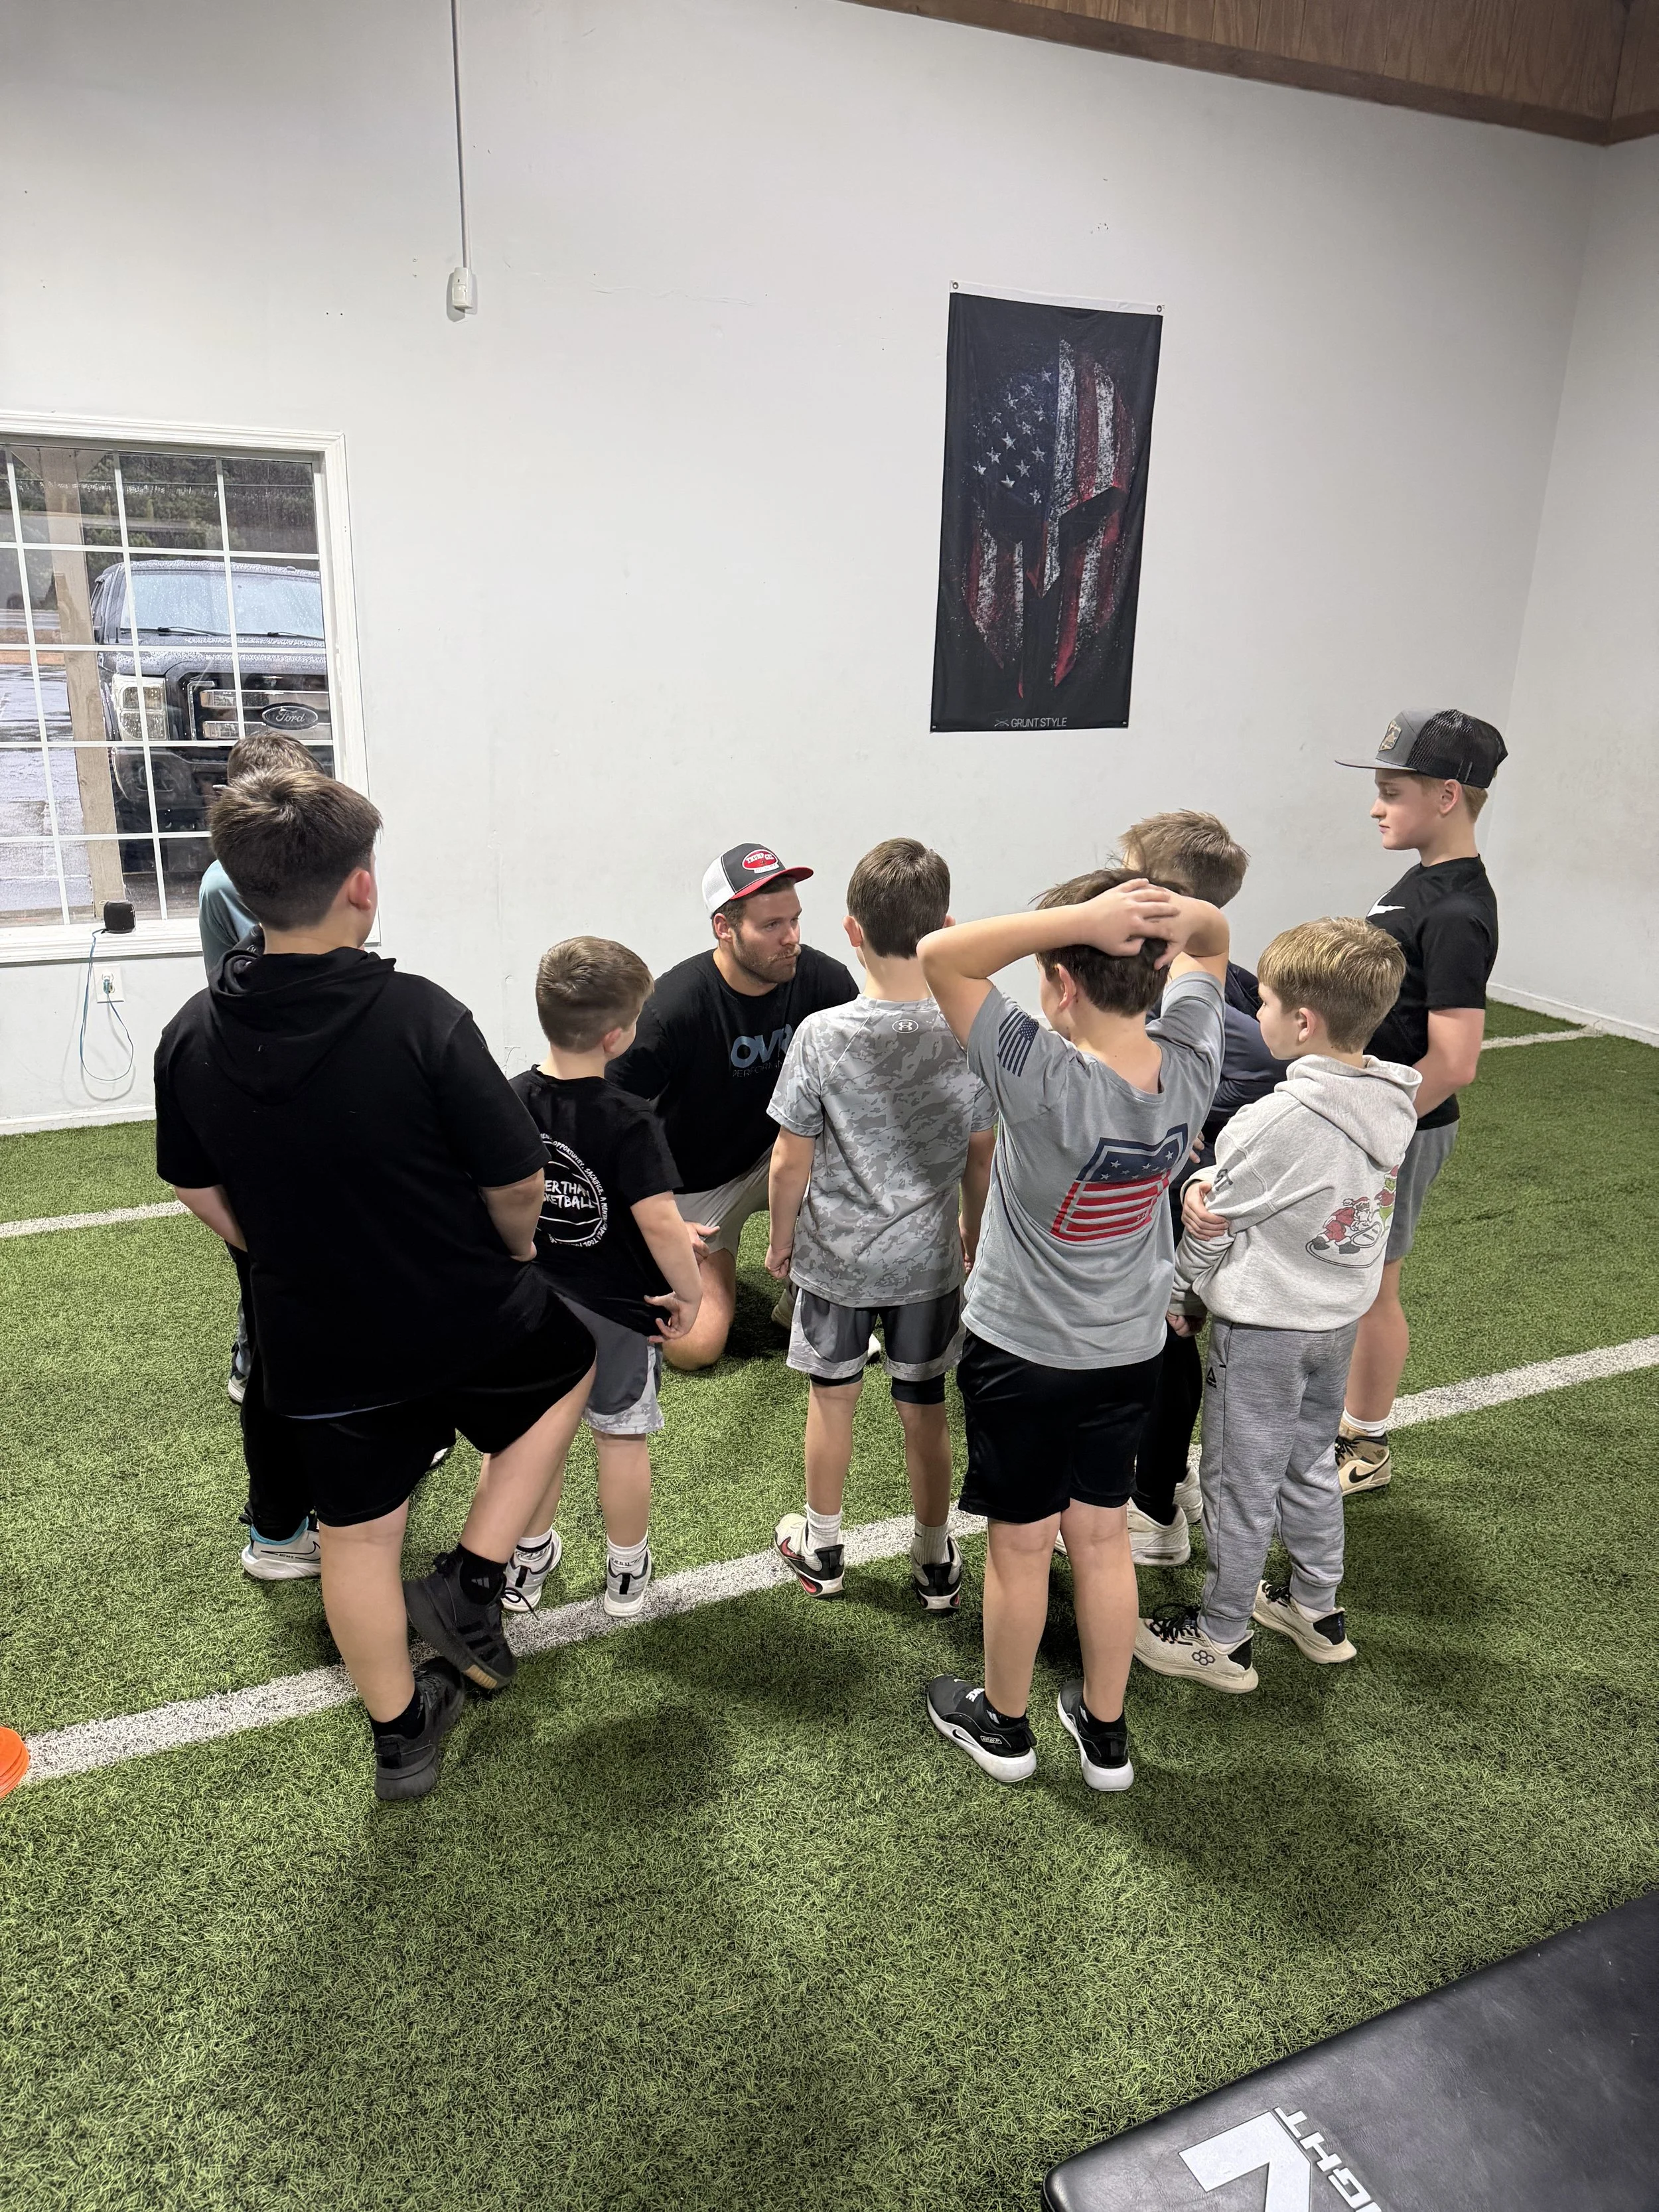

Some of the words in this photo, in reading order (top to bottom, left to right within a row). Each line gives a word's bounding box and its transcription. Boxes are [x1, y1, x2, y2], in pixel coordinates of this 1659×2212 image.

[276, 707, 305, 722] Ford
[1011, 718, 1039, 728] GRUNT
[1040, 717, 1068, 727] STYLE
[544, 1180, 562, 1195] ER
[543, 1192, 597, 1210] KETBALL
